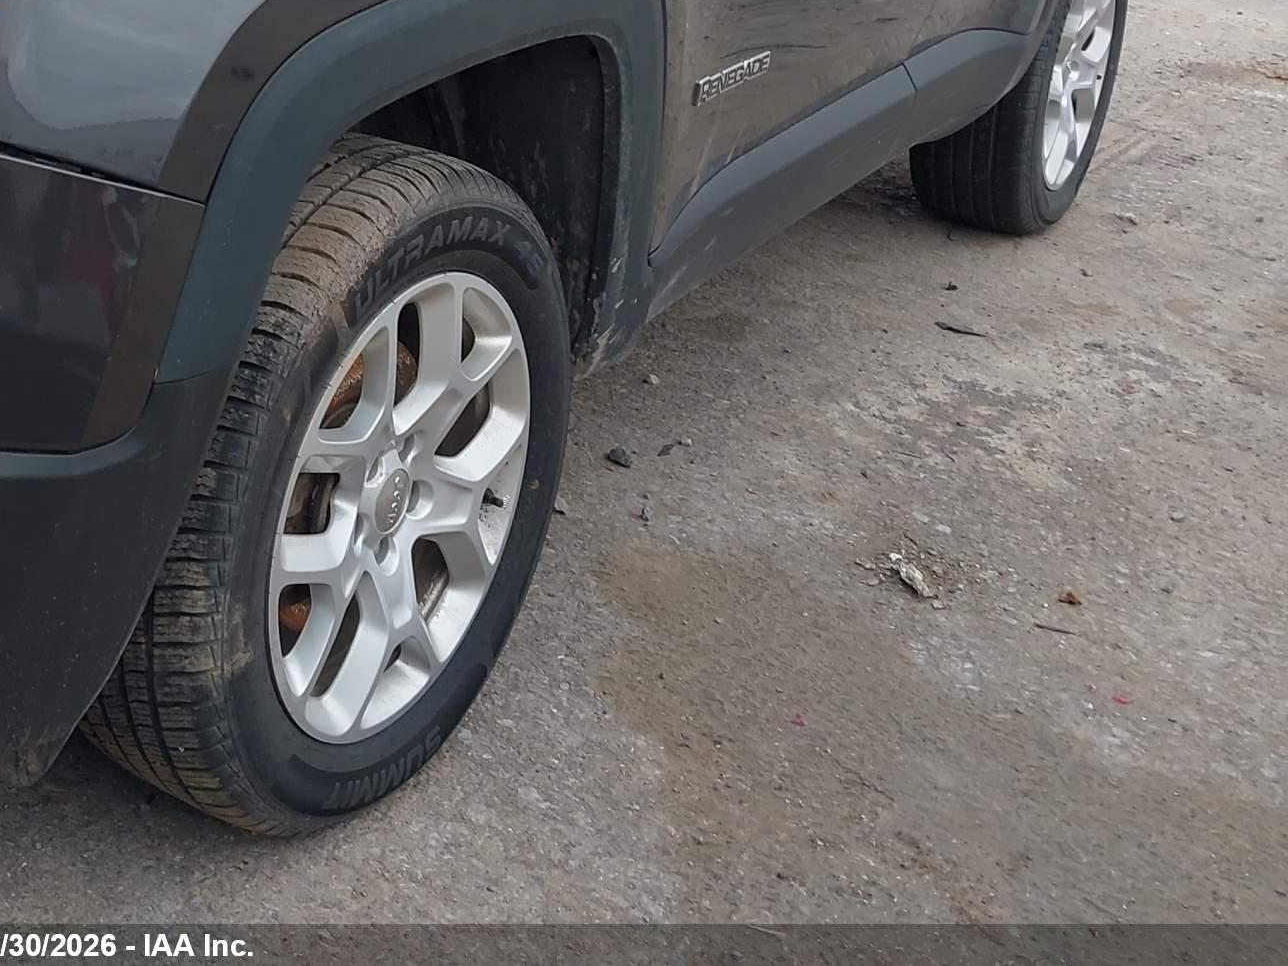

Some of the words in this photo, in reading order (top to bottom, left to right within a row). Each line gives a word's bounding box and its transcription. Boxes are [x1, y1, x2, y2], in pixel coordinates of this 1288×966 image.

[696, 50, 772, 106] RENEGADE
[354, 216, 511, 320] ULTRAMAX
[321, 726, 441, 810] SUMMIT
